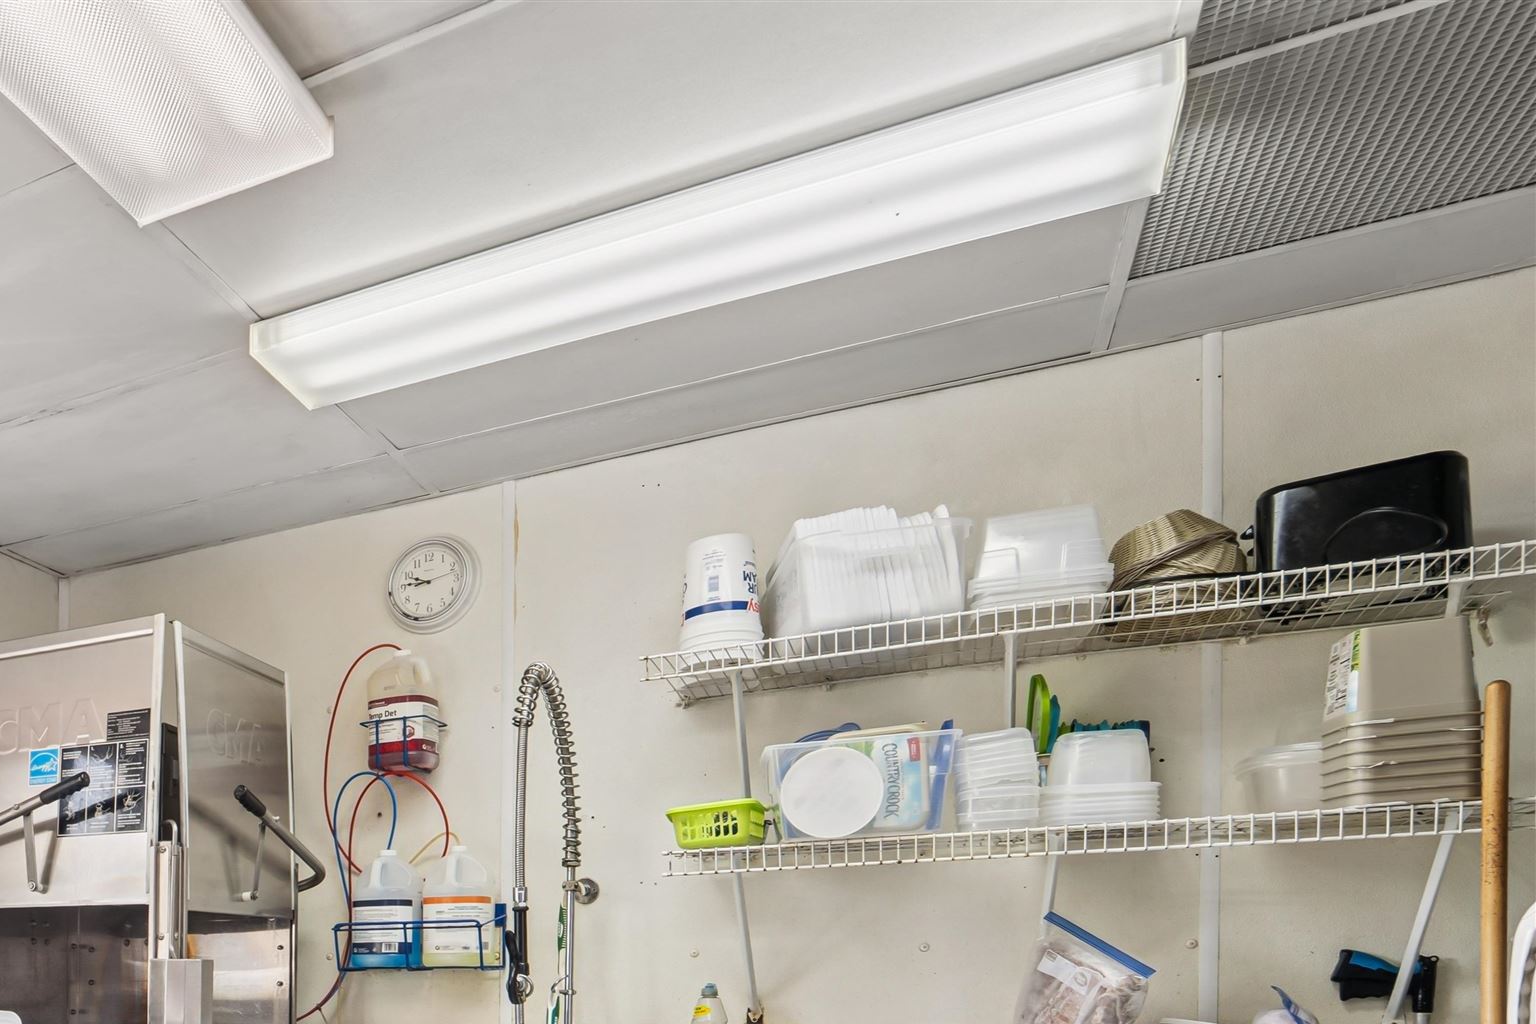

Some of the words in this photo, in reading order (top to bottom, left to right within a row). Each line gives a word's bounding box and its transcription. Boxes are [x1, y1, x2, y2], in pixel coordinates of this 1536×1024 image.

[424, 552, 434, 562] 12
[414, 559, 421, 569] 11
[449, 561, 456, 571] 2
[405, 571, 414, 580] 10
[400, 584, 406, 593] 9
[404, 595, 411, 604] 8
[414, 602, 420, 612] 7
[426, 603, 433, 612] 6
[384, 710, 397, 718] Det
[882, 743, 900, 785] COUNTRY
[884, 785, 901, 819] CROCK
